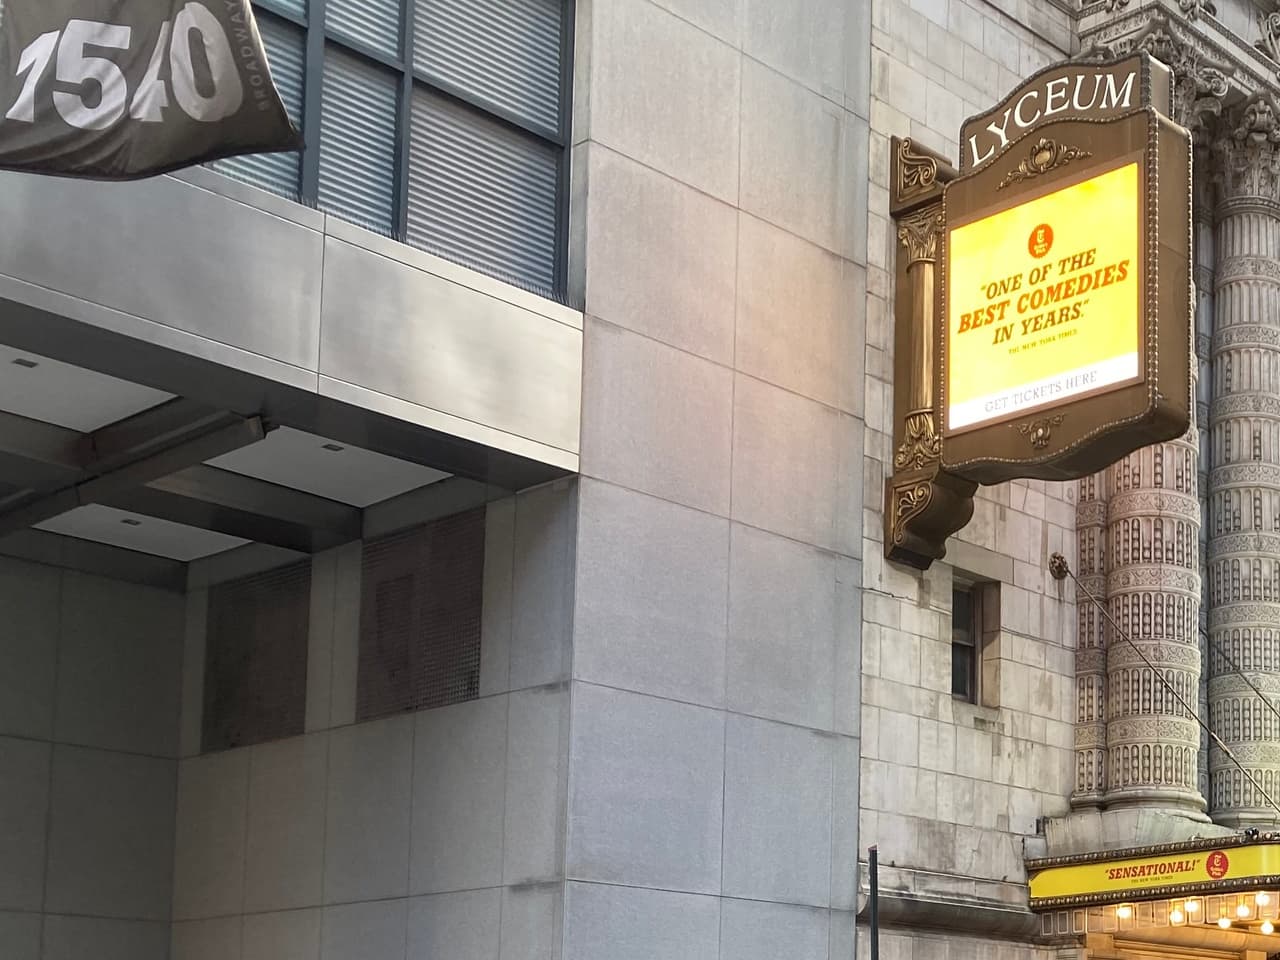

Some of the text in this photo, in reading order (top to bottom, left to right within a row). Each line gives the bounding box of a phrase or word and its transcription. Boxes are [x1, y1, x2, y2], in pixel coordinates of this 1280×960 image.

[5, 2, 243, 130] 1540
[969, 72, 1136, 168] LYCEUM
[1029, 263, 1052, 286] OF
[1058, 248, 1097, 276] THE
[957, 260, 1130, 334] BEST COMEDIES
[992, 323, 1015, 345] IN
[984, 370, 1098, 413] GET TICKETS HERE
